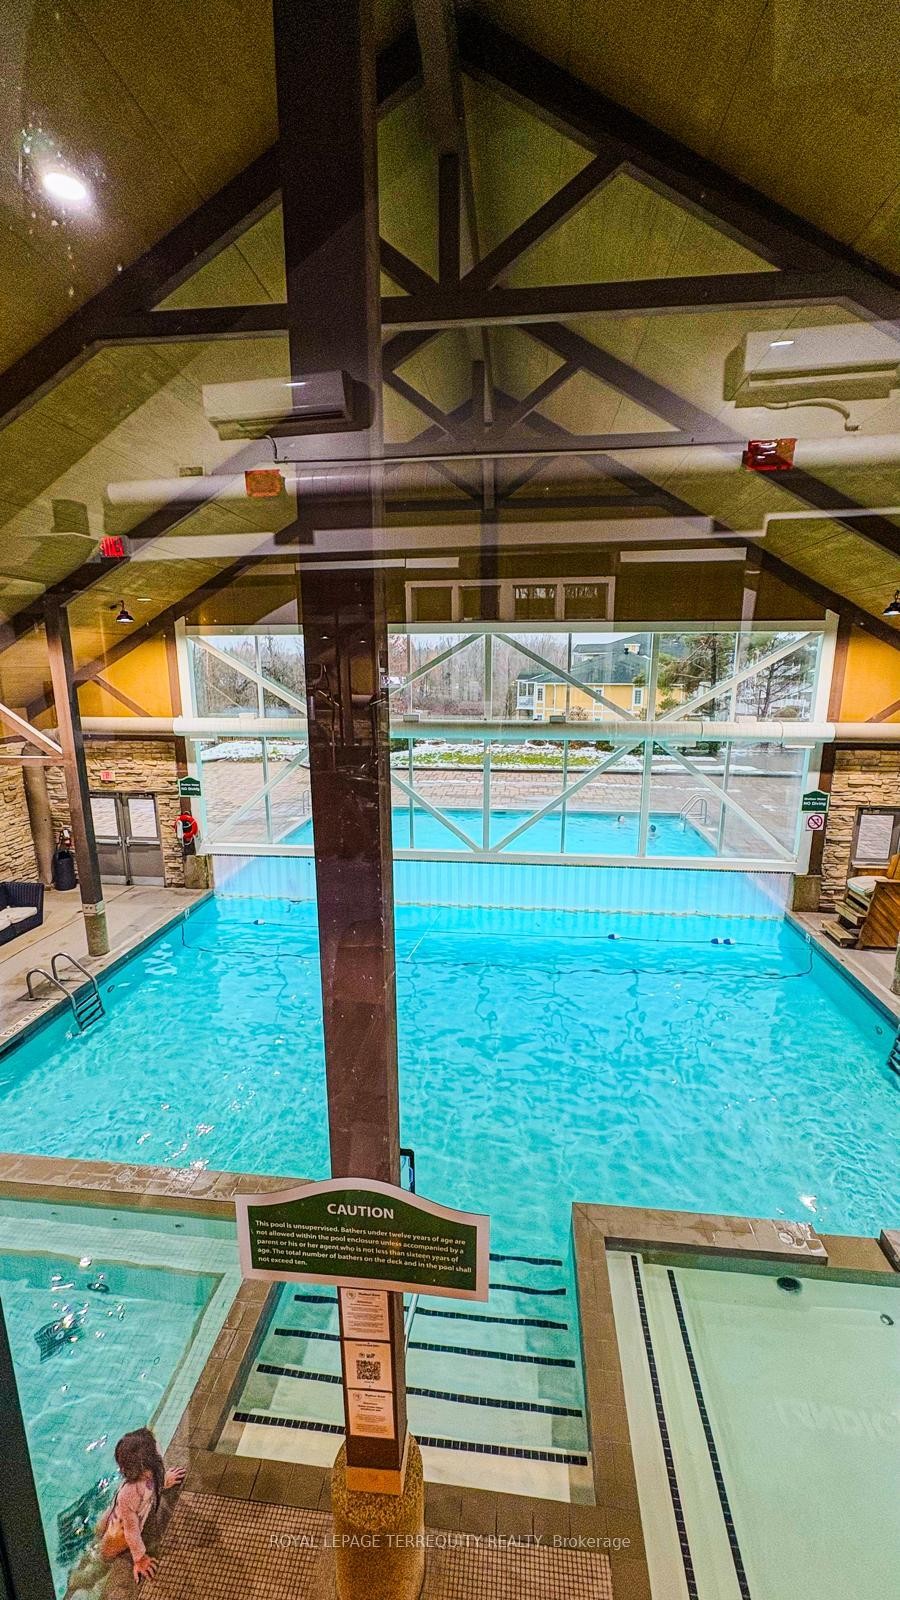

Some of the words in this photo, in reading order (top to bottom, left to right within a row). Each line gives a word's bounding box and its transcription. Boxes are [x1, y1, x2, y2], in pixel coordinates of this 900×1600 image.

[327, 1203, 394, 1219] CAUTION
[293, 1224, 339, 1233] unsupervised.
[341, 1227, 366, 1235] Bathers
[269, 1230, 294, 1238] allowed
[403, 1242, 448, 1253] accompanied
[450, 1246, 458, 1254] by
[406, 1252, 430, 1260] sixteen
